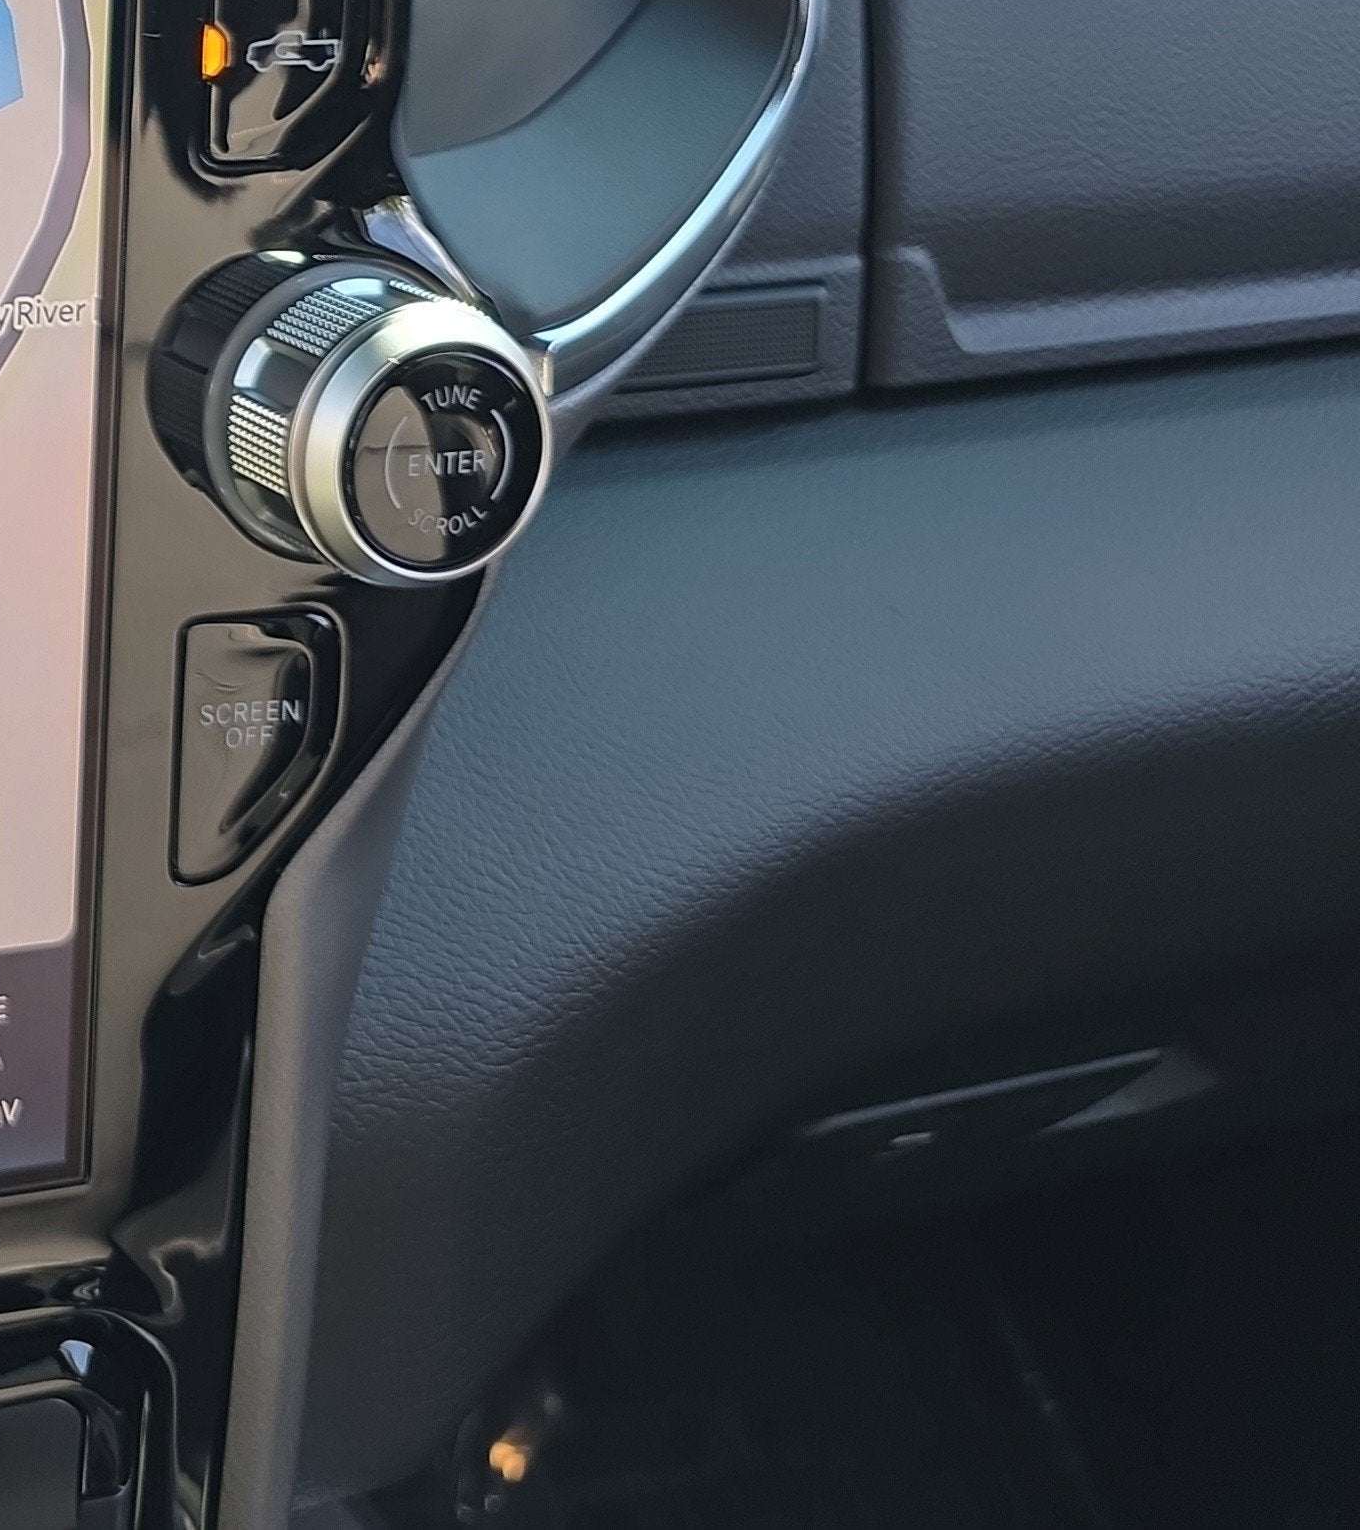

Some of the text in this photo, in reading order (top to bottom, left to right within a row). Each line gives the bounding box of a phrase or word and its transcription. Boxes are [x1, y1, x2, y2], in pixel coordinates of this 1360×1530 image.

[16, 298, 86, 326] River
[420, 384, 483, 412] TUNE
[408, 449, 487, 478] ENTER
[408, 505, 488, 537] SCROLL
[199, 699, 302, 728] SCREEN
[224, 725, 276, 751] OFF
